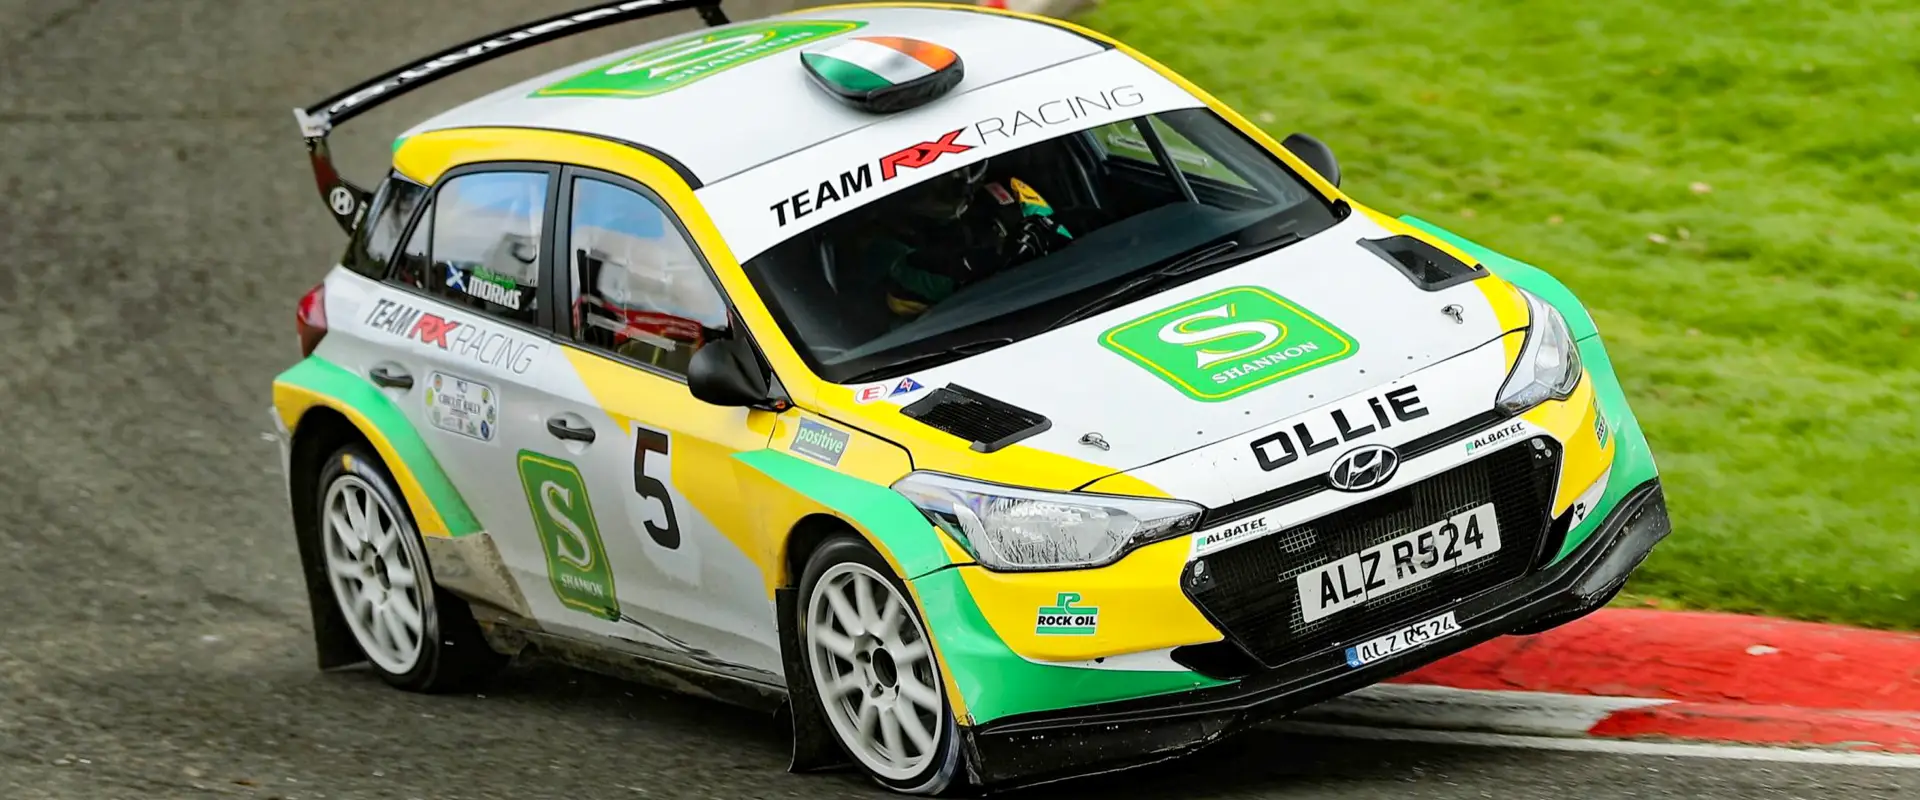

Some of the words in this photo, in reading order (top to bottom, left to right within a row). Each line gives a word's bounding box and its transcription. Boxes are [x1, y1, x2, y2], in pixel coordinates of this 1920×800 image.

[770, 164, 872, 227] TEAM
[879, 127, 978, 181] RX
[975, 85, 1144, 145] RACING
[468, 275, 521, 310] MORRIS
[365, 298, 419, 336] TEAM
[408, 313, 461, 350] RX
[451, 324, 540, 375] RACING
[1158, 304, 1286, 369] S
[1212, 342, 1319, 383] SHANNON
[862, 386, 881, 400] E
[796, 427, 843, 453] positive
[1250, 384, 1429, 472] OLLIE
[1474, 422, 1525, 448] ALBATEC
[634, 427, 681, 550] 5
[541, 480, 595, 571] S
[1206, 517, 1267, 544] ALBATEC
[1320, 550, 1386, 610] ALZ
[1392, 513, 1484, 580] R524
[1038, 616, 1072, 626] ROCK
[1075, 616, 1096, 626] OIL
[1362, 634, 1401, 661] ALZ
[1403, 616, 1455, 646] R524
